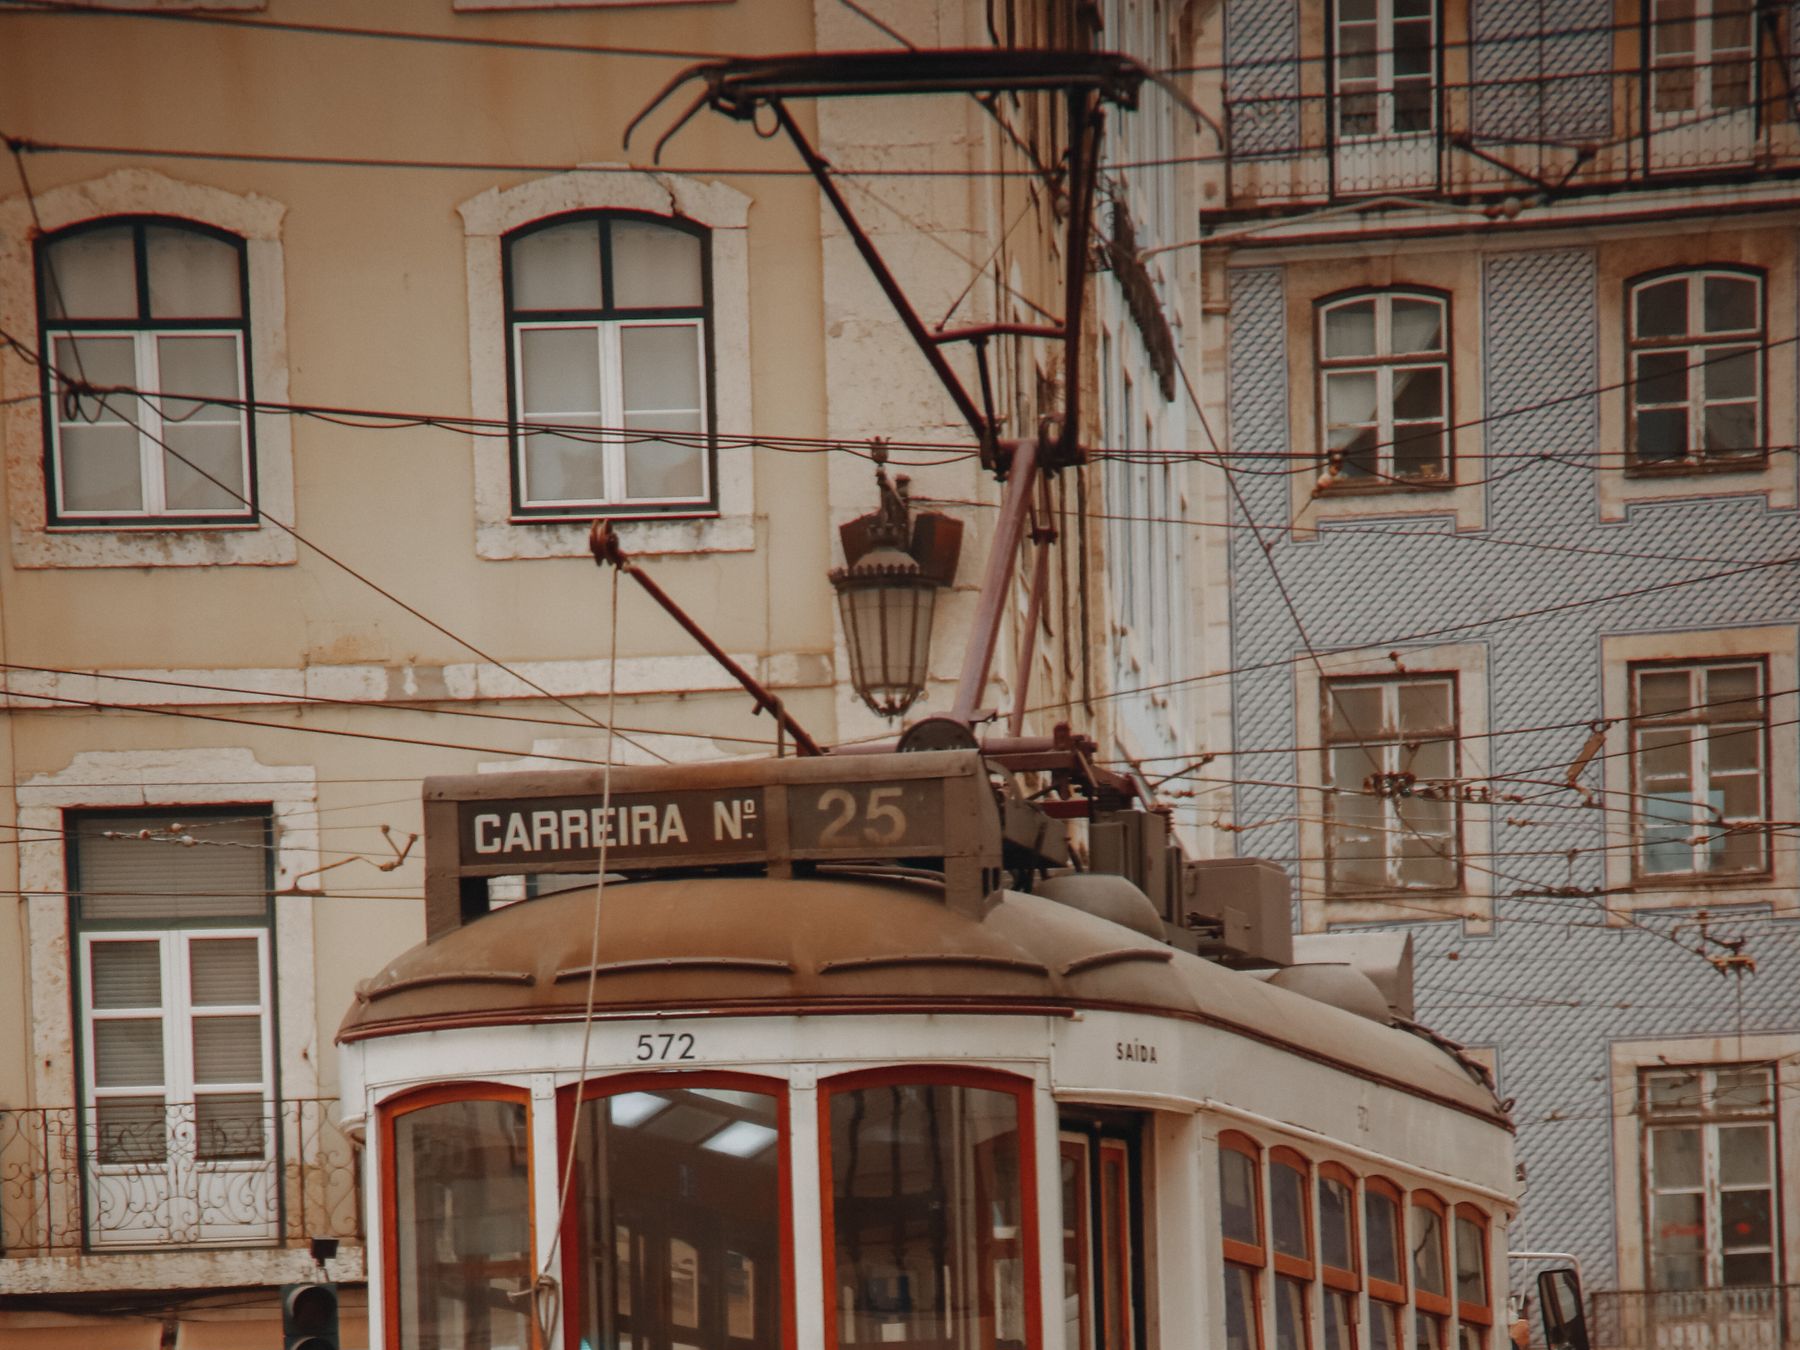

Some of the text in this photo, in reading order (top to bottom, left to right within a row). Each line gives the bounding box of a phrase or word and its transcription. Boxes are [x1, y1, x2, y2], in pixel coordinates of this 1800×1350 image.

[474, 803, 689, 855] CARREIRA
[816, 786, 908, 850] 25
[635, 1033, 696, 1062] 572
